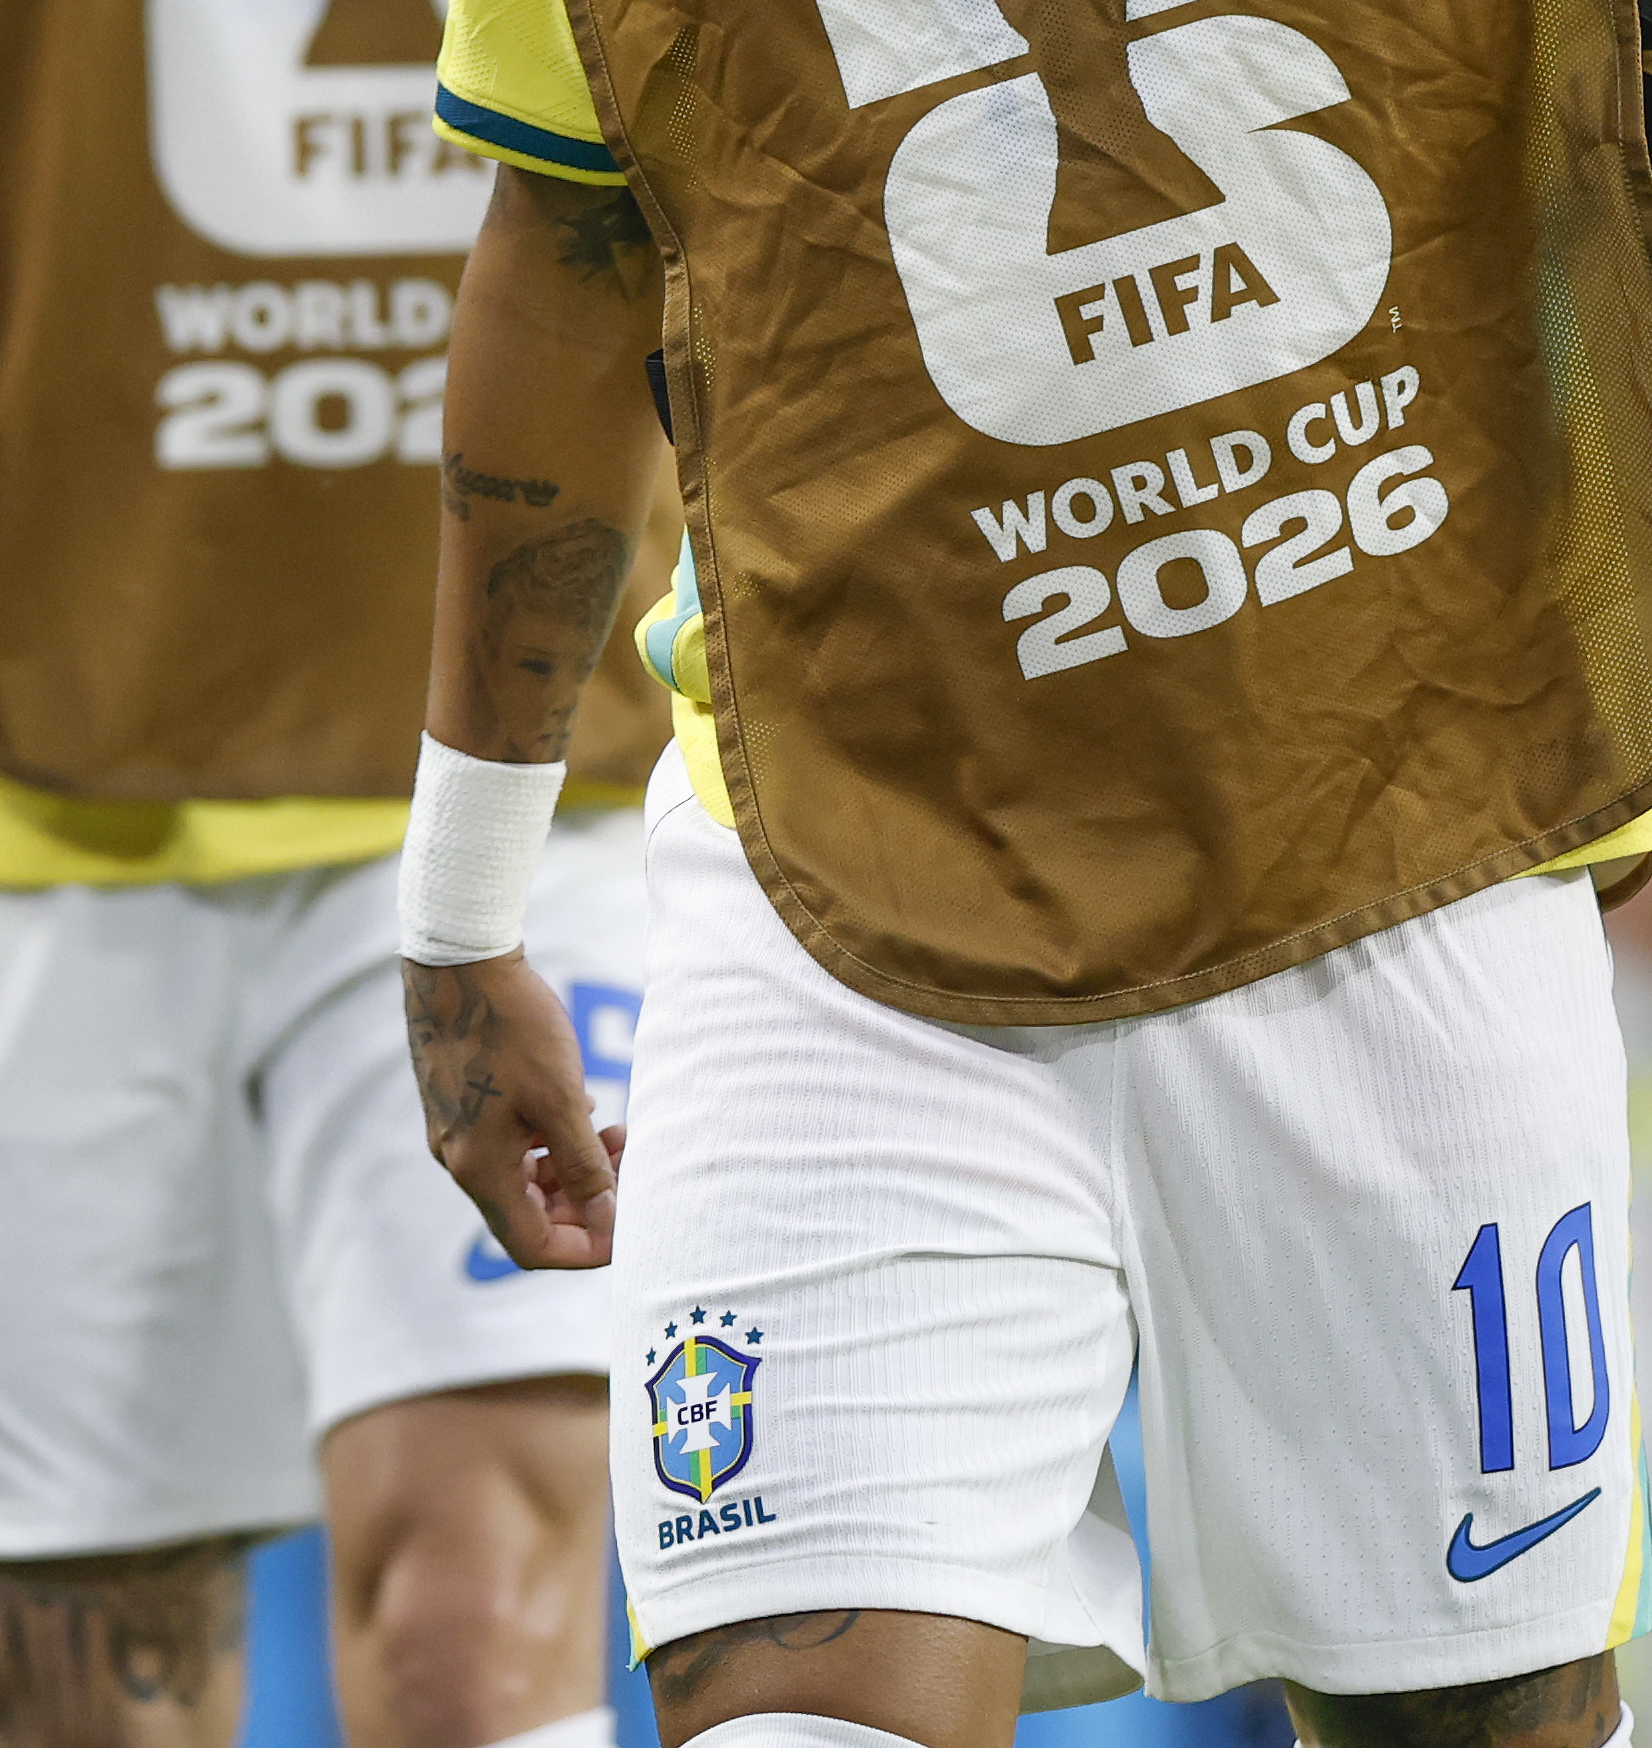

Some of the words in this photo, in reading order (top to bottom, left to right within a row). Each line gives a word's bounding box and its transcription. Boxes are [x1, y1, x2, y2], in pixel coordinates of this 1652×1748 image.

[154, 279, 451, 353] WORLD
[1052, 241, 1281, 366] FIFA
[970, 428, 1271, 563] WORLD
[1286, 364, 1422, 465] CUP
[1001, 442, 1450, 682] 2026
[1451, 1200, 1610, 1474] 10
[677, 1399, 718, 1426] CBF
[658, 1496, 777, 1550] BRASIL
